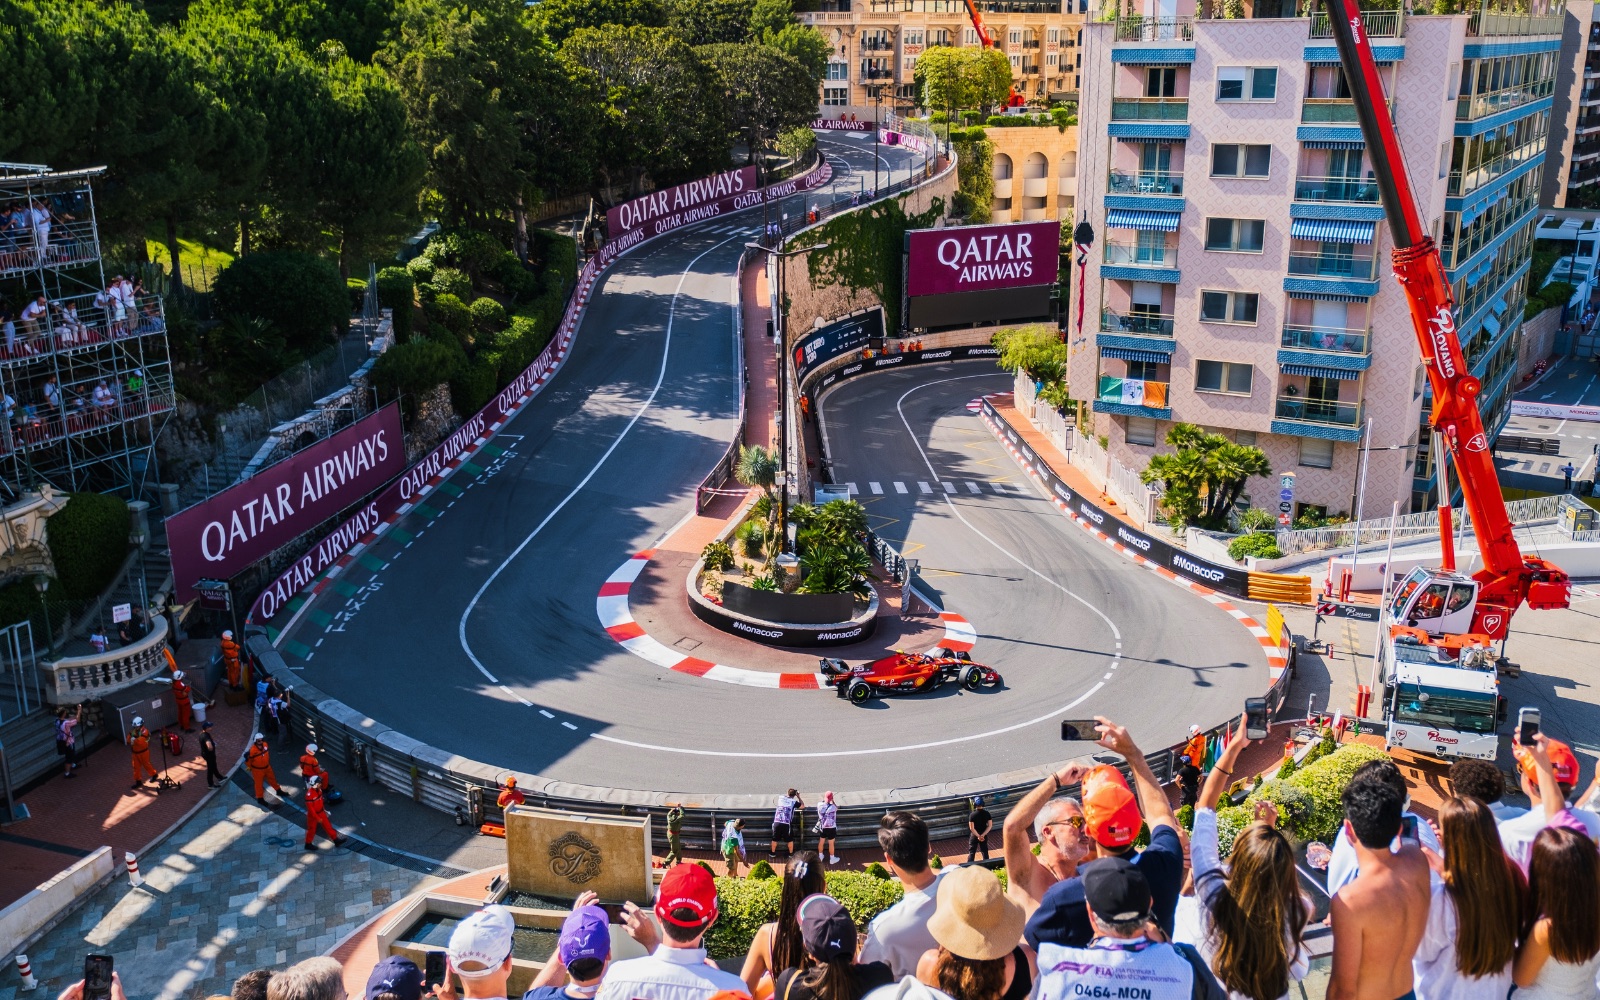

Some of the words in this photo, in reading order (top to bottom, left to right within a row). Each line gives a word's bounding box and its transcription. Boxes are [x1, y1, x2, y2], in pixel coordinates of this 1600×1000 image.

[825, 120, 865, 130] AIRWAYS
[620, 190, 670, 230] QATAR
[673, 169, 743, 211] AIRWAYS
[733, 192, 763, 210] QATAR
[765, 181, 797, 200] AIRWAYS
[655, 213, 681, 234] QATAR
[683, 203, 720, 224] AIRWAYS
[600, 242, 617, 264] QATAR
[617, 227, 645, 254] AIRWAYS
[937, 233, 1033, 271] QATAR
[958, 260, 1033, 284] AIRWAYS
[921, 350, 952, 360] #MonacoGP
[1427, 305, 1456, 379] PIOVANO
[498, 375, 526, 414] QATAR
[526, 347, 553, 389] AIRWAYS
[400, 451, 441, 500] QATAR
[442, 412, 485, 466] AIRWAYS
[201, 483, 295, 562] QATAR
[300, 429, 388, 509] AIRWAYS
[1118, 527, 1151, 551] #MonacoGP
[261, 555, 315, 619] QATAR
[318, 501, 379, 572] AIRWAYS
[1173, 554, 1225, 582] #MonacoGP
[332, 582, 384, 632] TAXIS
[733, 621, 784, 639] #MonacoGP
[817, 627, 862, 641] #MonacoGP
[1095, 965, 1113, 977] FIA
[1074, 983, 1152, 1000] 0464-MON
